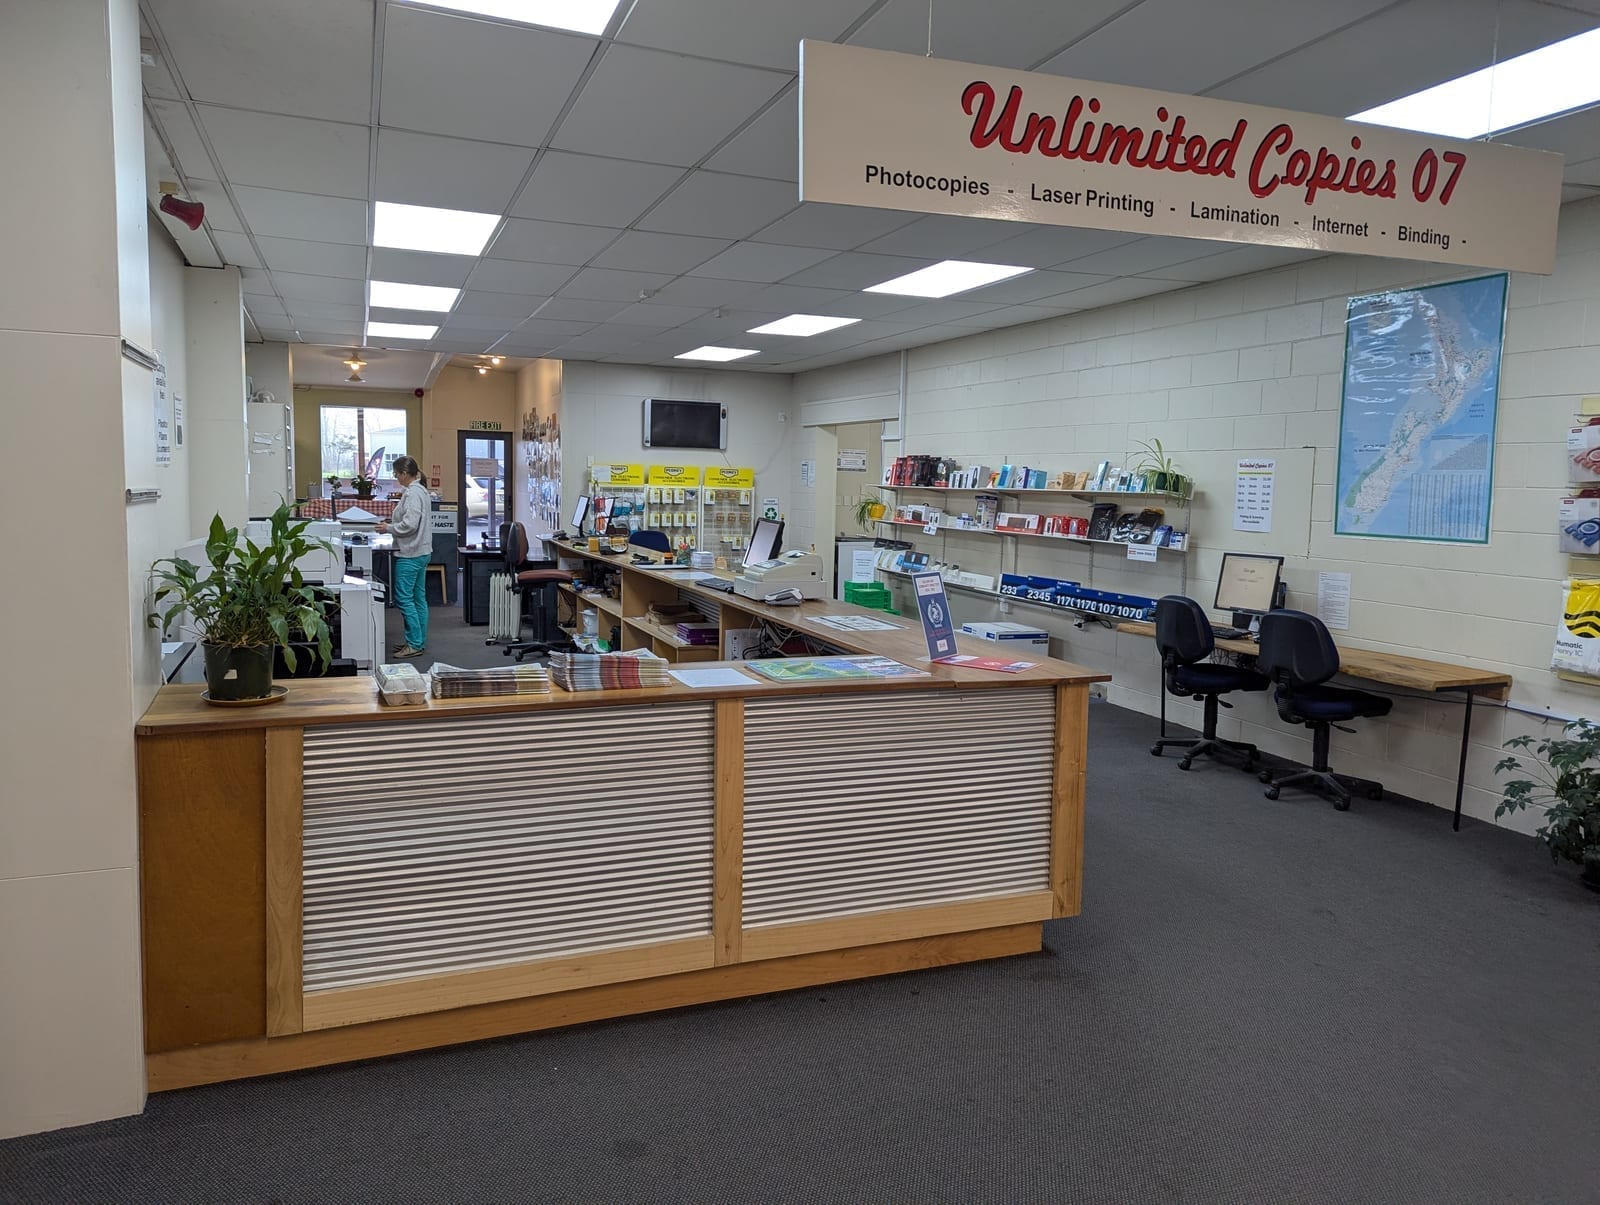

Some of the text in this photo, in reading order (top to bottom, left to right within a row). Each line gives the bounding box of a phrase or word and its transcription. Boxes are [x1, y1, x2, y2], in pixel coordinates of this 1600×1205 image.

[961, 81, 1467, 206] Unlimited Copies 07
[865, 164, 990, 197] Photocopies
[1031, 183, 1082, 206] Laser
[1085, 189, 1154, 218] Printing
[1191, 201, 1280, 227] Lamination
[1312, 215, 1369, 237] Internet
[1398, 226, 1451, 249] Binding
[470, 421, 502, 430] FIRE EXIT
[1001, 584, 1017, 595] 233
[1026, 589, 1051, 601] 2345
[1076, 598, 1097, 611] 1170
[1117, 606, 1143, 619] 1070
[1556, 639, 1583, 650] Numatic
